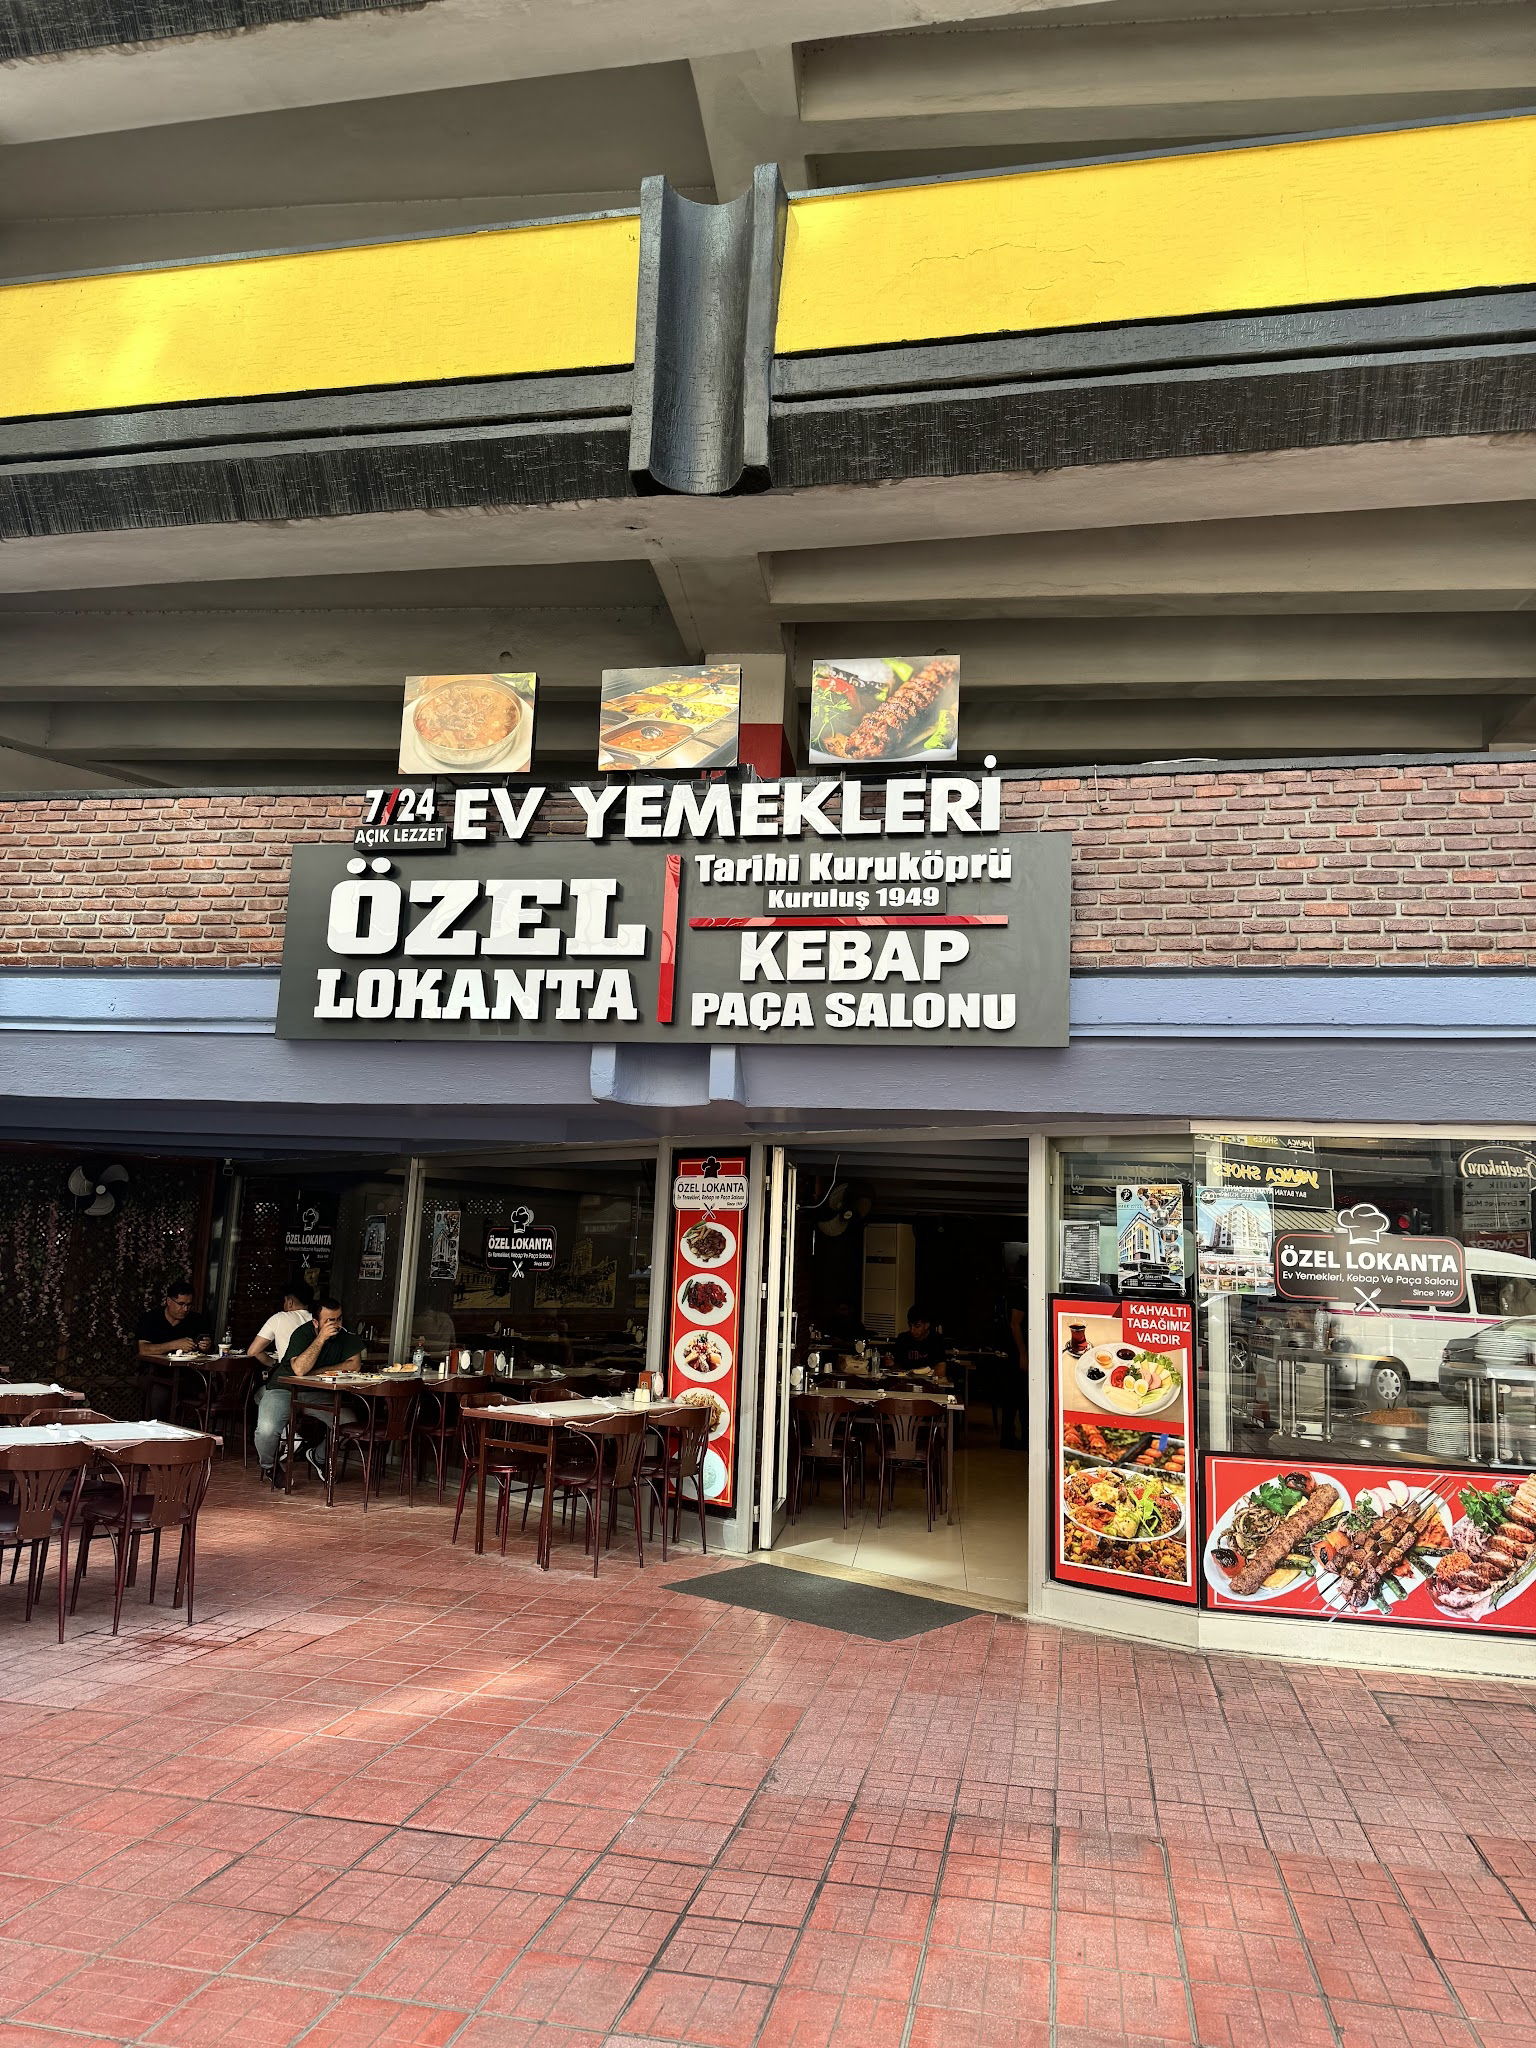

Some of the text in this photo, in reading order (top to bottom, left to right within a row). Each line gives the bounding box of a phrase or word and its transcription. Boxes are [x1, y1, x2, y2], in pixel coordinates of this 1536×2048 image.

[366, 788, 435, 825] 7/24
[452, 754, 1000, 840] EV YEMEKLERİ
[354, 827, 444, 847] AÇIK LEZZET
[695, 848, 1012, 883] Tarihi Kuruköprü
[327, 857, 647, 955] ÖZEL
[768, 886, 940, 911] Kuruluş 1949
[740, 930, 970, 981] KEBAP
[314, 969, 639, 1021] LOKANTA
[691, 992, 1016, 1031] PAÇA SALONU
[676, 1181, 745, 1193] ÖZEL LOKANTA
[302, 1234, 332, 1246] LOKANTA
[488, 1235, 553, 1250] ÖZEL LOKANTA
[1280, 1244, 1459, 1273] ÖZEL LOKANTA
[1282, 1270, 1294, 1280] Ev
[1347, 1273, 1380, 1285] Kebap
[1381, 1274, 1394, 1284] Ve
[1396, 1276, 1422, 1286] Paça
[1424, 1276, 1459, 1286] Salonu
[1412, 1288, 1454, 1298] Since 1949
[1129, 1303, 1187, 1318] KAHVALTI
[1126, 1318, 1191, 1333] TABAĞIMIZ
[1136, 1331, 1181, 1346] VARDIR
